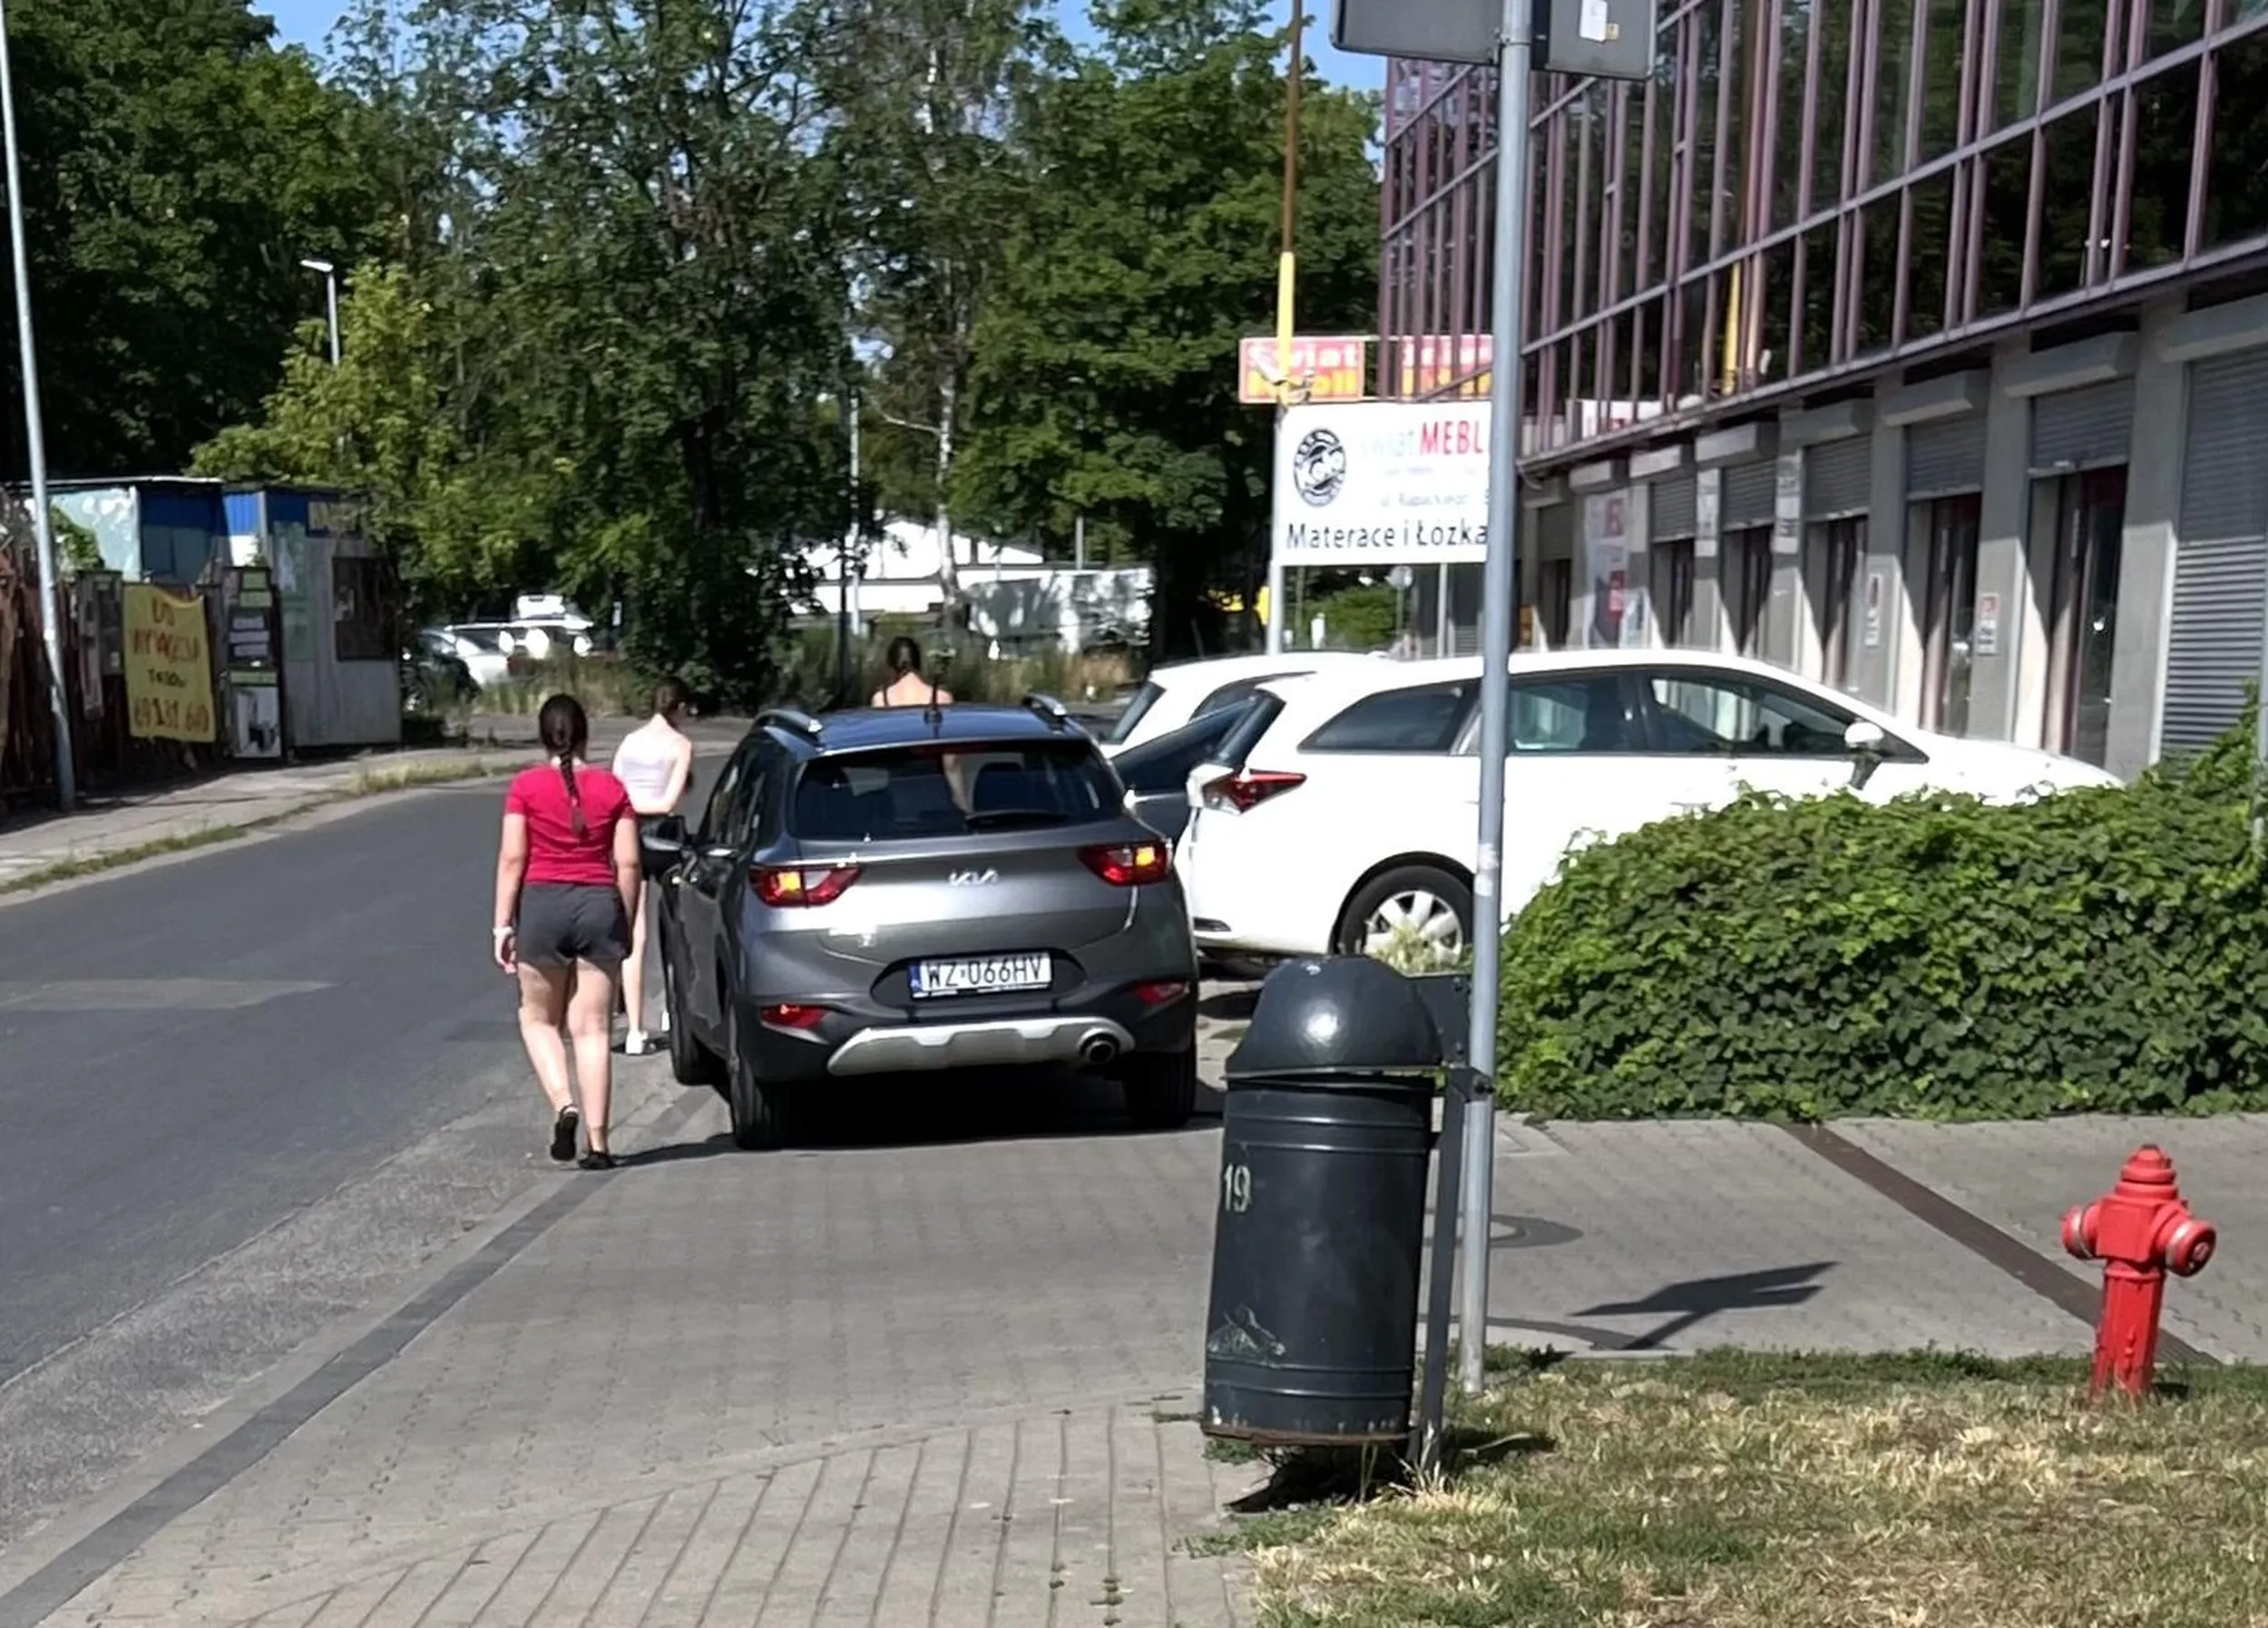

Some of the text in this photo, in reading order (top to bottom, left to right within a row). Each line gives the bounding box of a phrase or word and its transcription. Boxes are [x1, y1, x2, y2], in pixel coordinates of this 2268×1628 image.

[1286, 522, 1395, 549] Materace
[925, 961, 959, 988] WZ
[1223, 1163, 1252, 1213] 19
